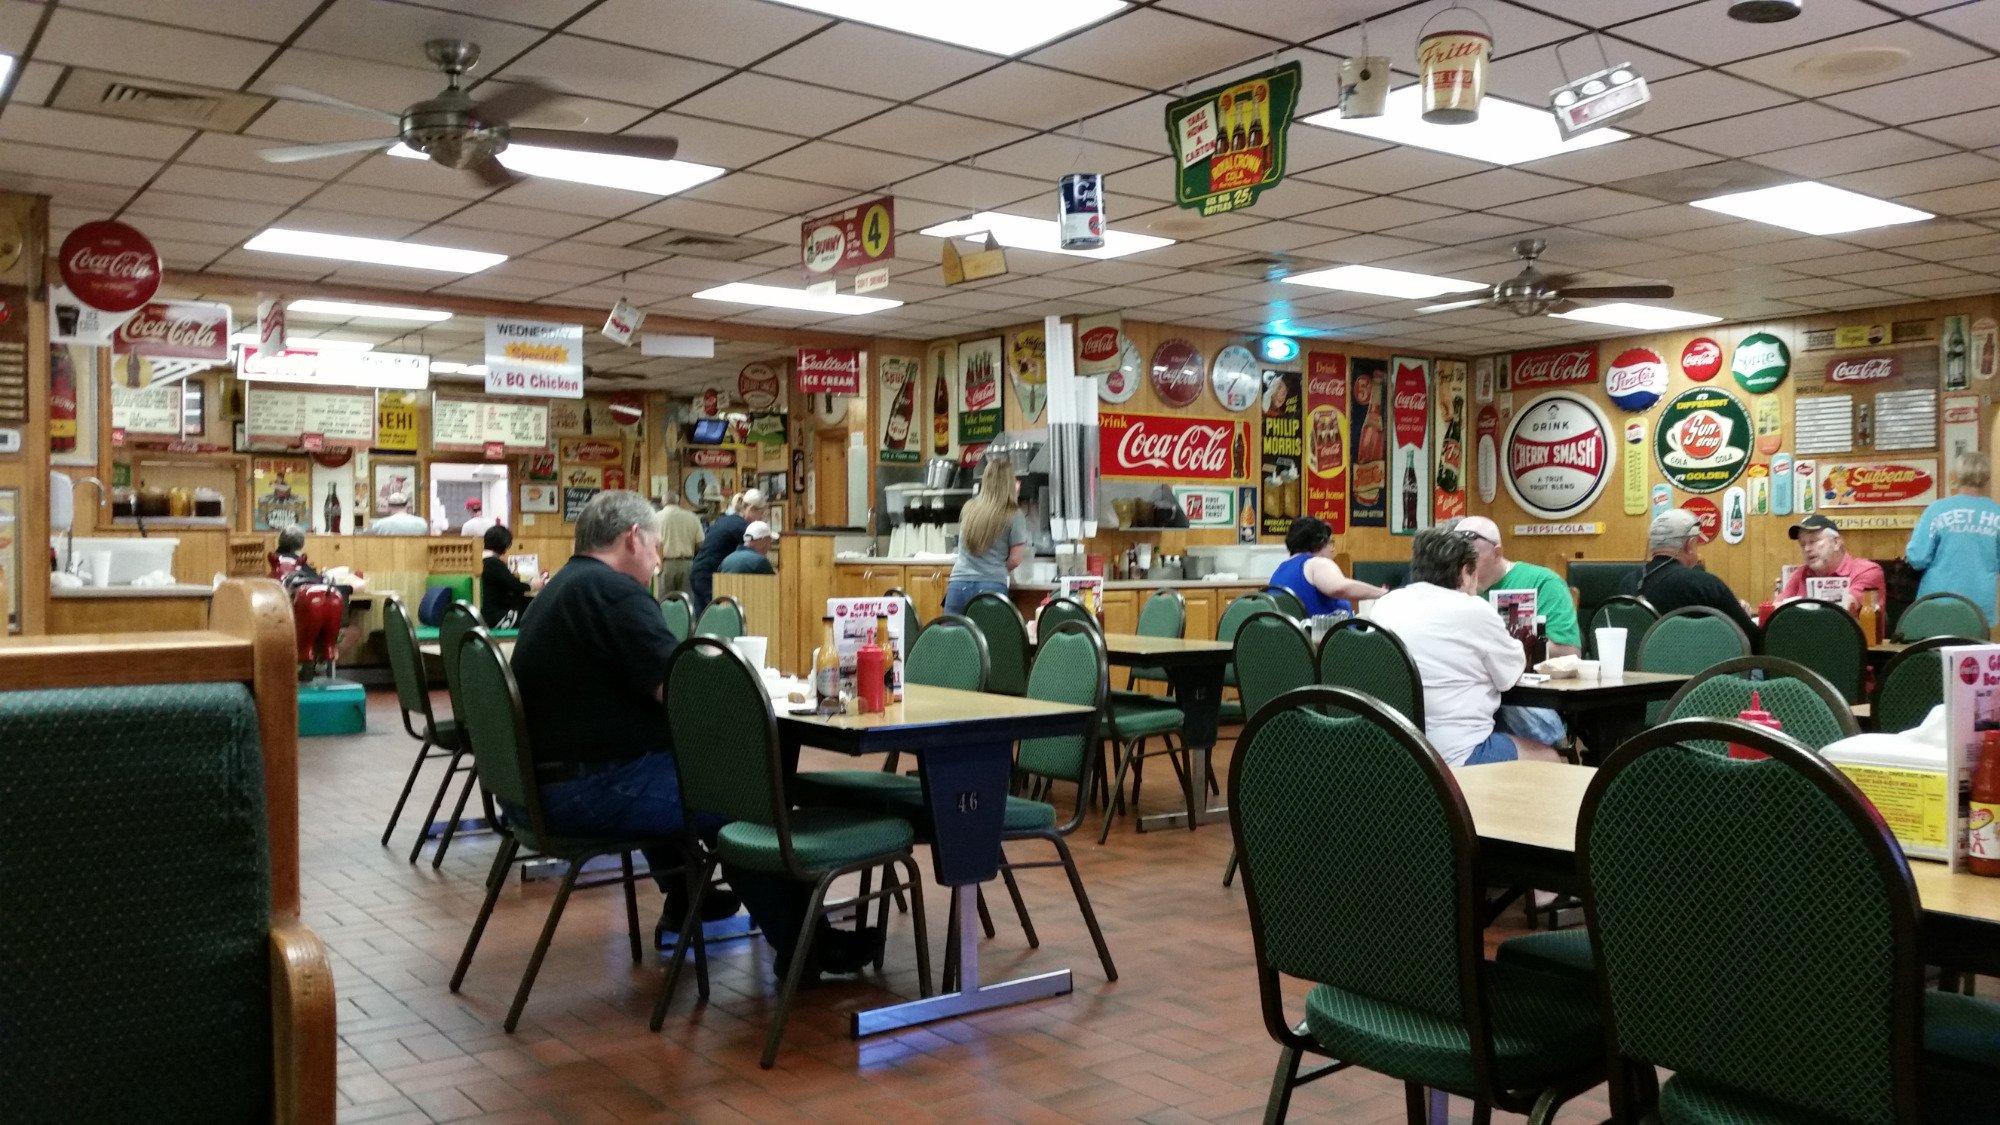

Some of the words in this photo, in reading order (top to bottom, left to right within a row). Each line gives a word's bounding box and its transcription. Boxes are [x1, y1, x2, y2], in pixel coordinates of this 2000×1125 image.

[1187, 109, 1206, 127] TAKE
[1185, 140, 1218, 163] CARTON
[1233, 153, 1262, 175] CROWN
[867, 212, 882, 251] 4
[1514, 351, 1593, 384] Coca-Cola
[1833, 358, 1894, 381] Coca-Cola
[530, 373, 579, 391] Chicken
[803, 375, 819, 385] ICE
[821, 375, 855, 387] CREAM
[1099, 413, 1128, 429] Drink
[1265, 418, 1300, 437] PHILIP
[1532, 421, 1570, 432] DRINK
[1117, 421, 1232, 472] Coca-Cola
[1263, 436, 1302, 455] MORRIS
[1695, 436, 1720, 448] drop
[1514, 442, 1550, 471] CHERRY
[1553, 436, 1597, 469] SMASH
[1670, 456, 1688, 466] COLA
[1715, 453, 1733, 463] COLA
[1686, 471, 1729, 481] GOLDEN
[1851, 465, 1917, 486] Sunbeam
[1526, 524, 1586, 534] PEPSI-COLA
[853, 602, 883, 610] GARY'S
[958, 791, 978, 812] 46
